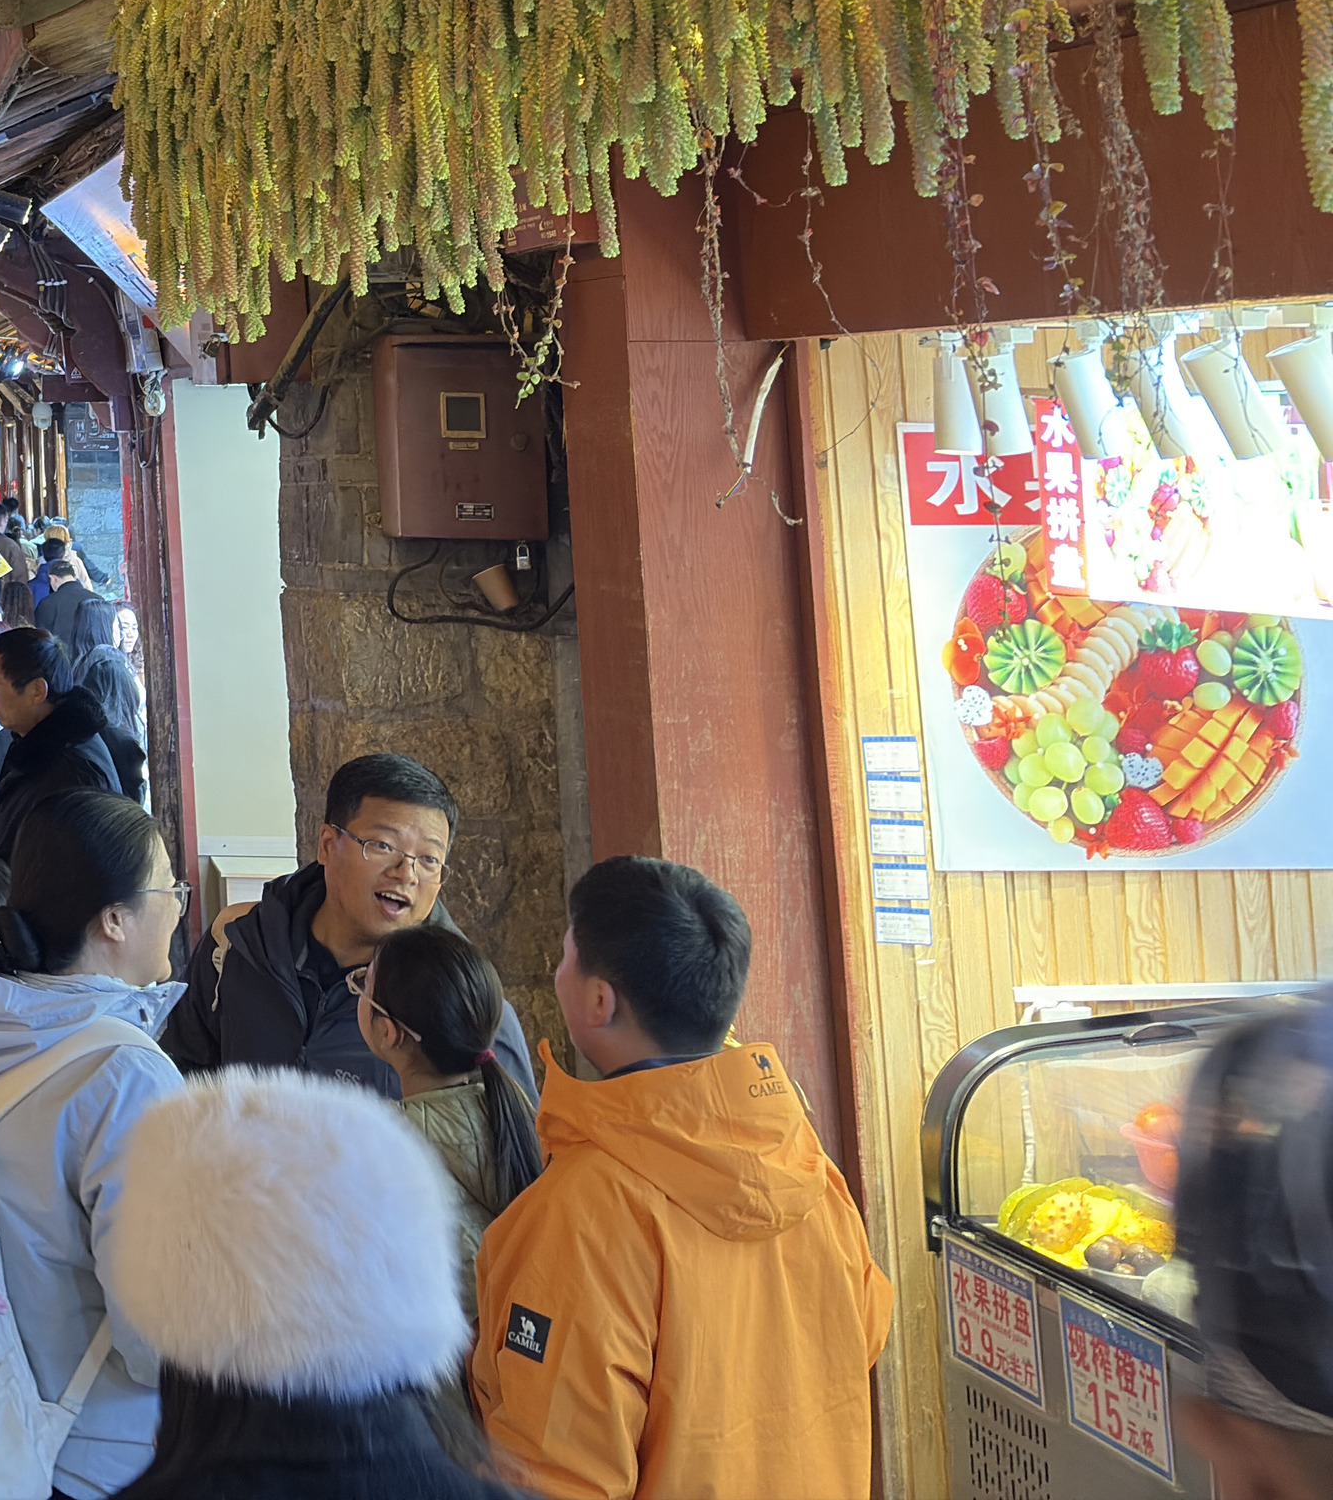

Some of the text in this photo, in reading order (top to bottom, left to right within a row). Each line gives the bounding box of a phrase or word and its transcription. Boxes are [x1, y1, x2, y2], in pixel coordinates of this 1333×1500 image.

[748, 1081, 788, 1099] CAMEL
[953, 1267, 1032, 1338] 水果拼盘
[508, 1331, 542, 1354] CAMEL
[1067, 1322, 1161, 1411] 现榨橙汁
